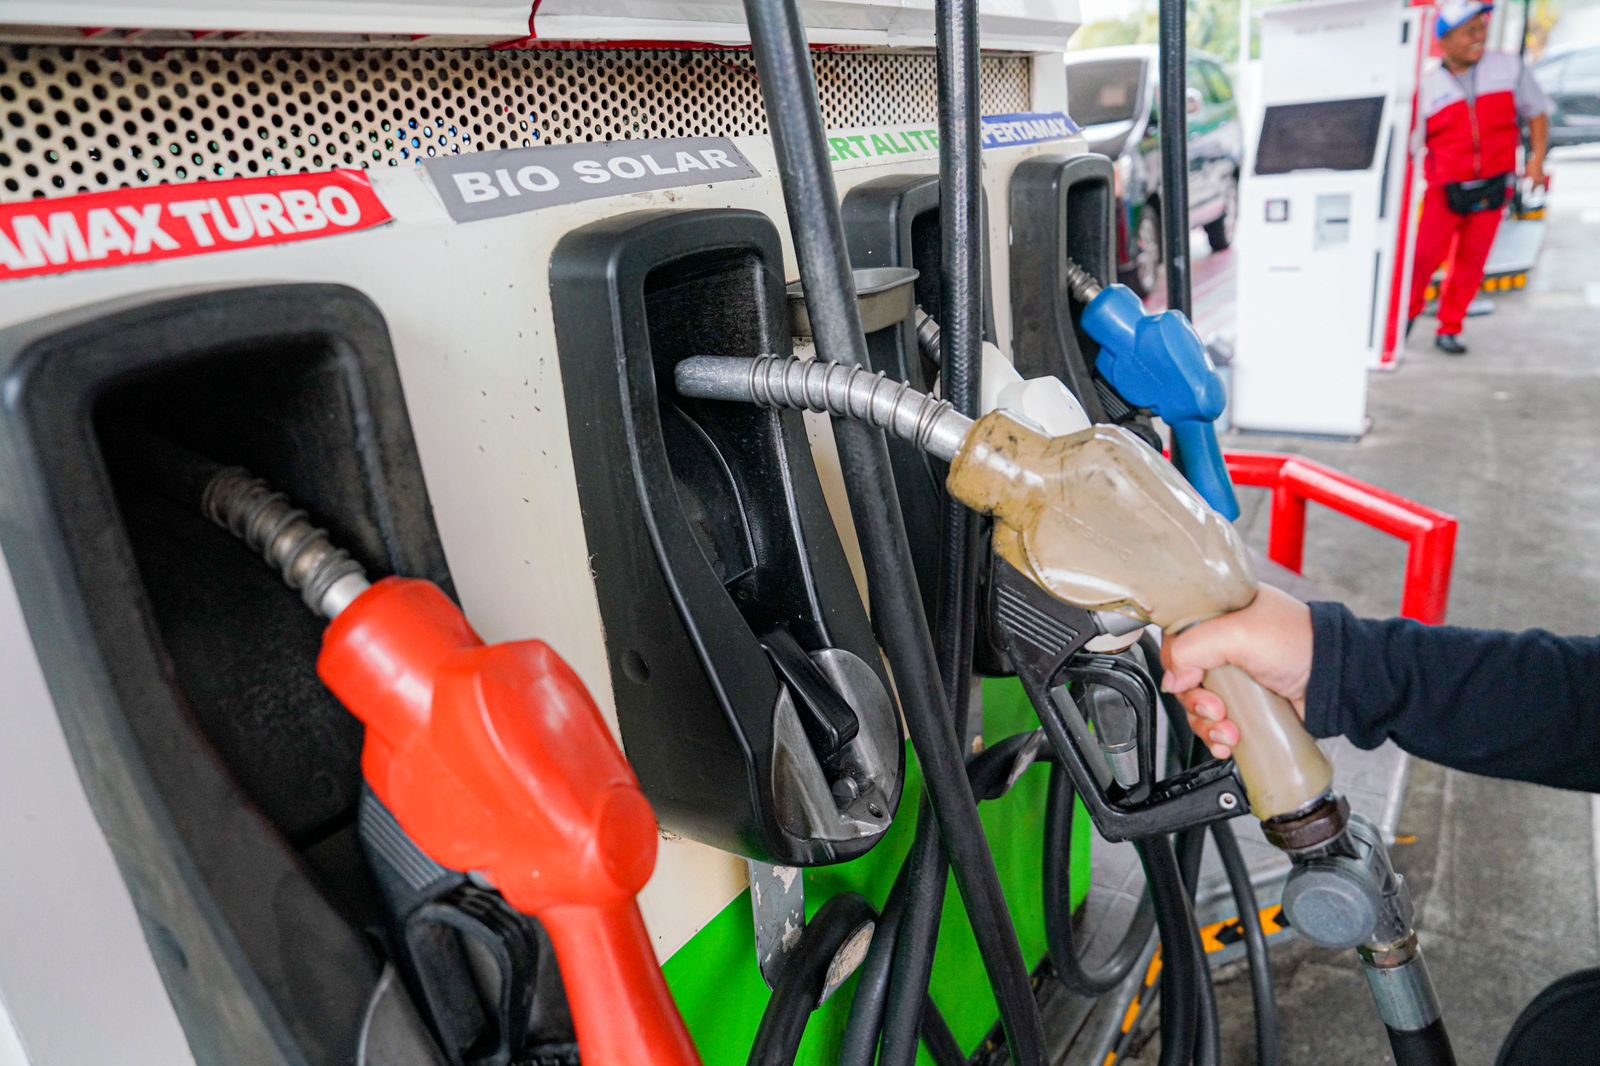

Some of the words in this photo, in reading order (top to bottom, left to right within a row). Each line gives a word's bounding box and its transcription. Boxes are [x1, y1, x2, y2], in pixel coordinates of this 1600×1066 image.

[981, 118, 1072, 144] PERTAMAX
[451, 165, 560, 204] BIO
[573, 149, 738, 184] SOLAR
[168, 185, 361, 247] TURBO
